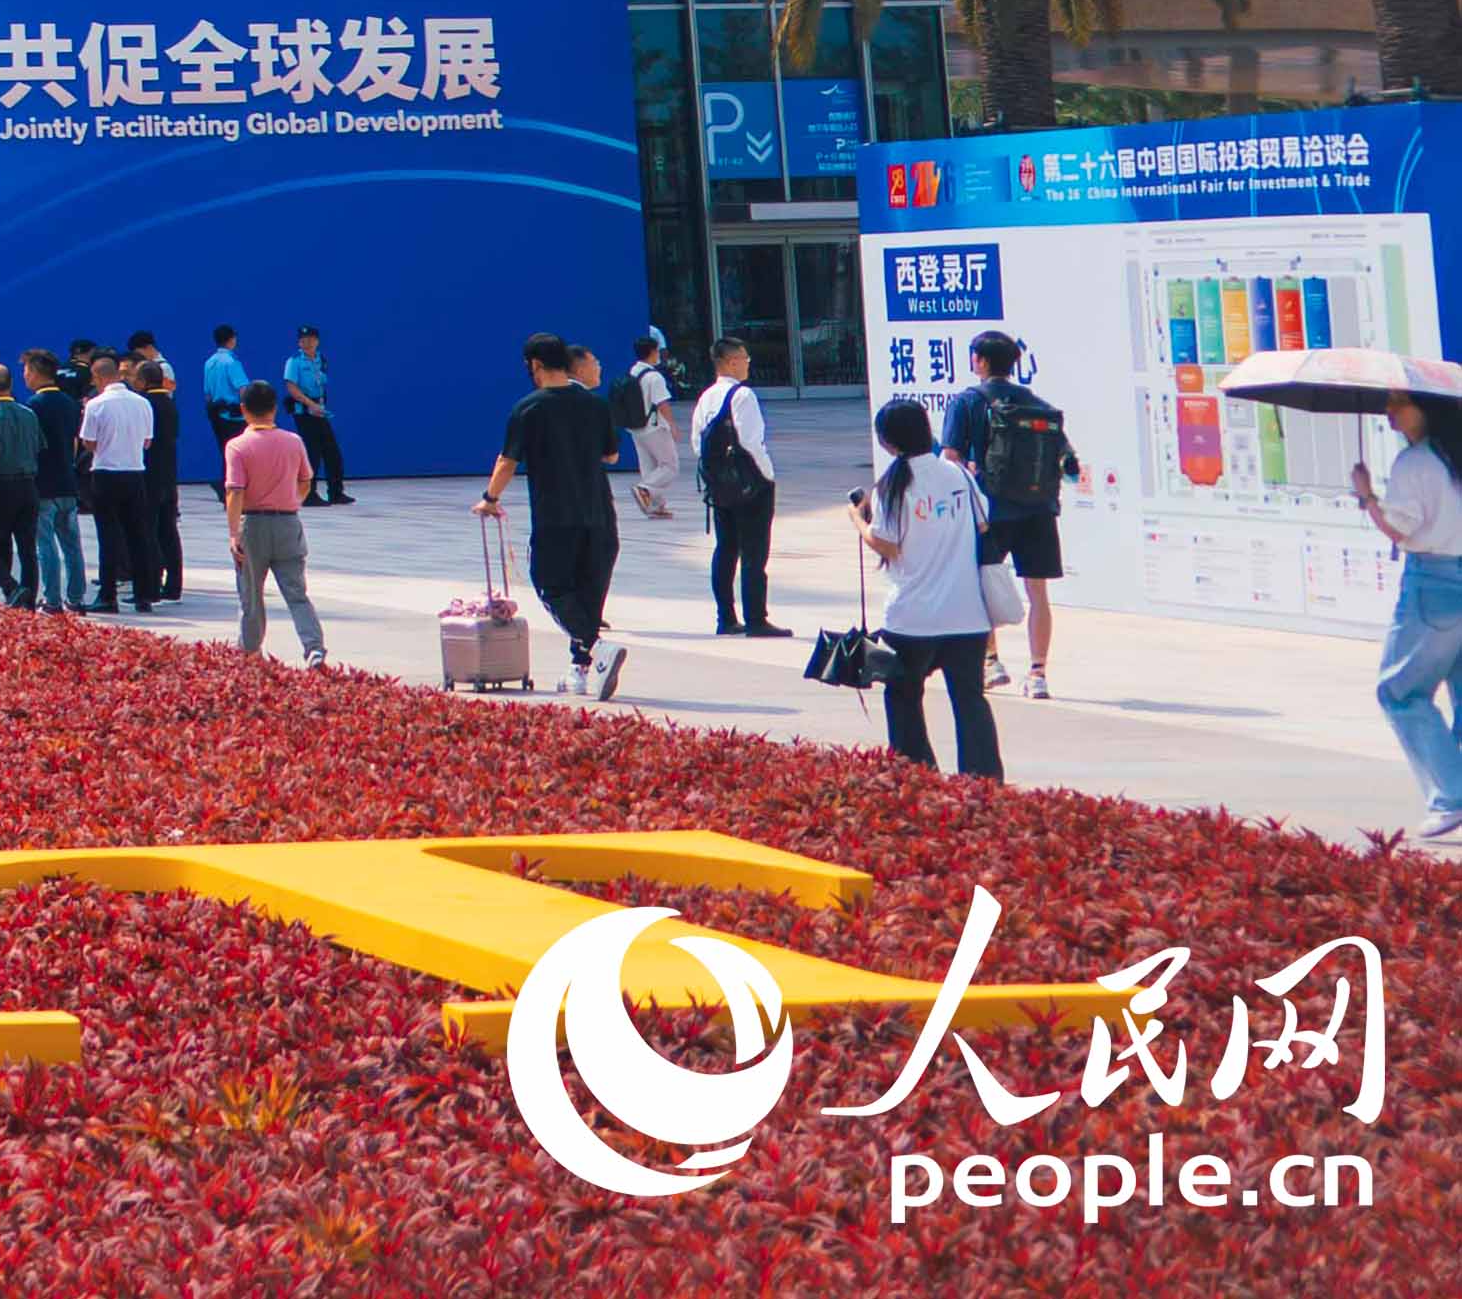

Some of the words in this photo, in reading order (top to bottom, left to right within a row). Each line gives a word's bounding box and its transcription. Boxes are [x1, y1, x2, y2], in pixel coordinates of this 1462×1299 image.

[96, 113, 239, 141] Facilitating
[247, 111, 328, 135] Global
[336, 107, 503, 137] Development
[1043, 133, 1370, 183] 第二十六届中国国际投资贸易洽谈会
[1122, 180, 1197, 198] International
[1201, 179, 1225, 194] Fair
[1250, 175, 1318, 190] Investment
[1335, 172, 1371, 187] Trade
[895, 253, 987, 294] 西登录厅
[907, 297, 938, 314] West
[941, 295, 979, 316] Lobby
[890, 336, 1038, 385] 报到心
